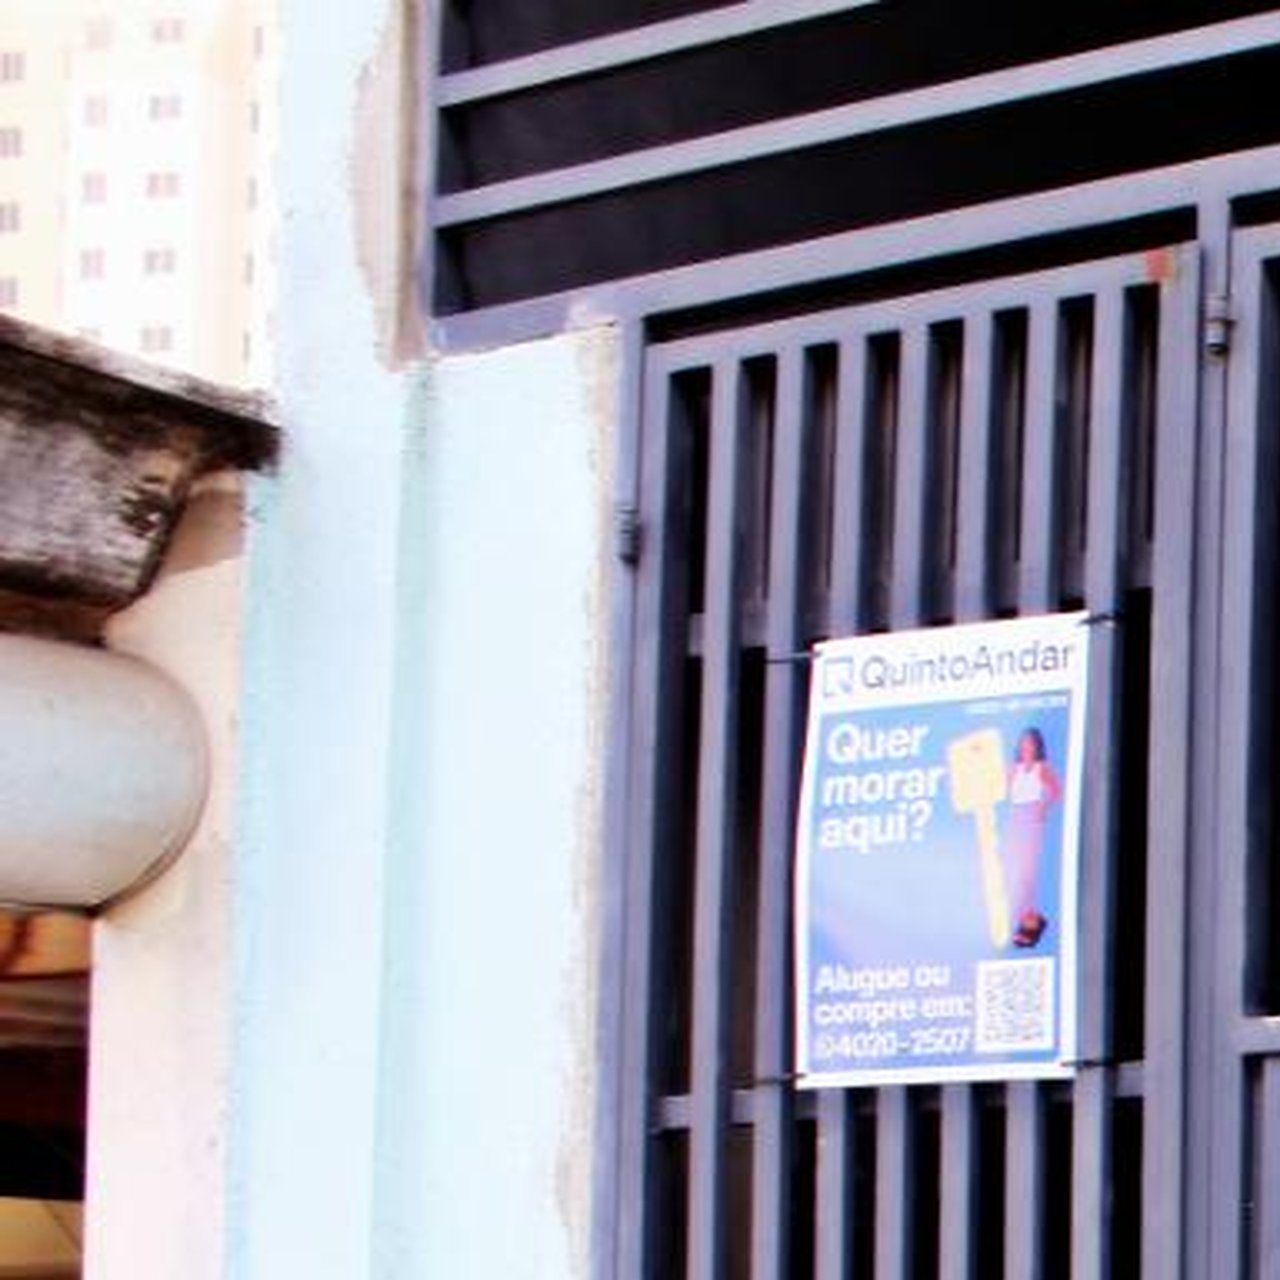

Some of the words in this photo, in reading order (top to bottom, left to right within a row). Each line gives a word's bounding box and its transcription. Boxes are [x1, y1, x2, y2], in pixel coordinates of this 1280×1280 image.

[861, 639, 1071, 689] QuintoAndar
[826, 722, 930, 764] Quer
[822, 764, 944, 808] morar
[819, 799, 932, 854] aqui?
[814, 965, 910, 998] Alugue
[914, 964, 951, 988] ou
[814, 998, 917, 1028] compre
[920, 995, 974, 1018] em:
